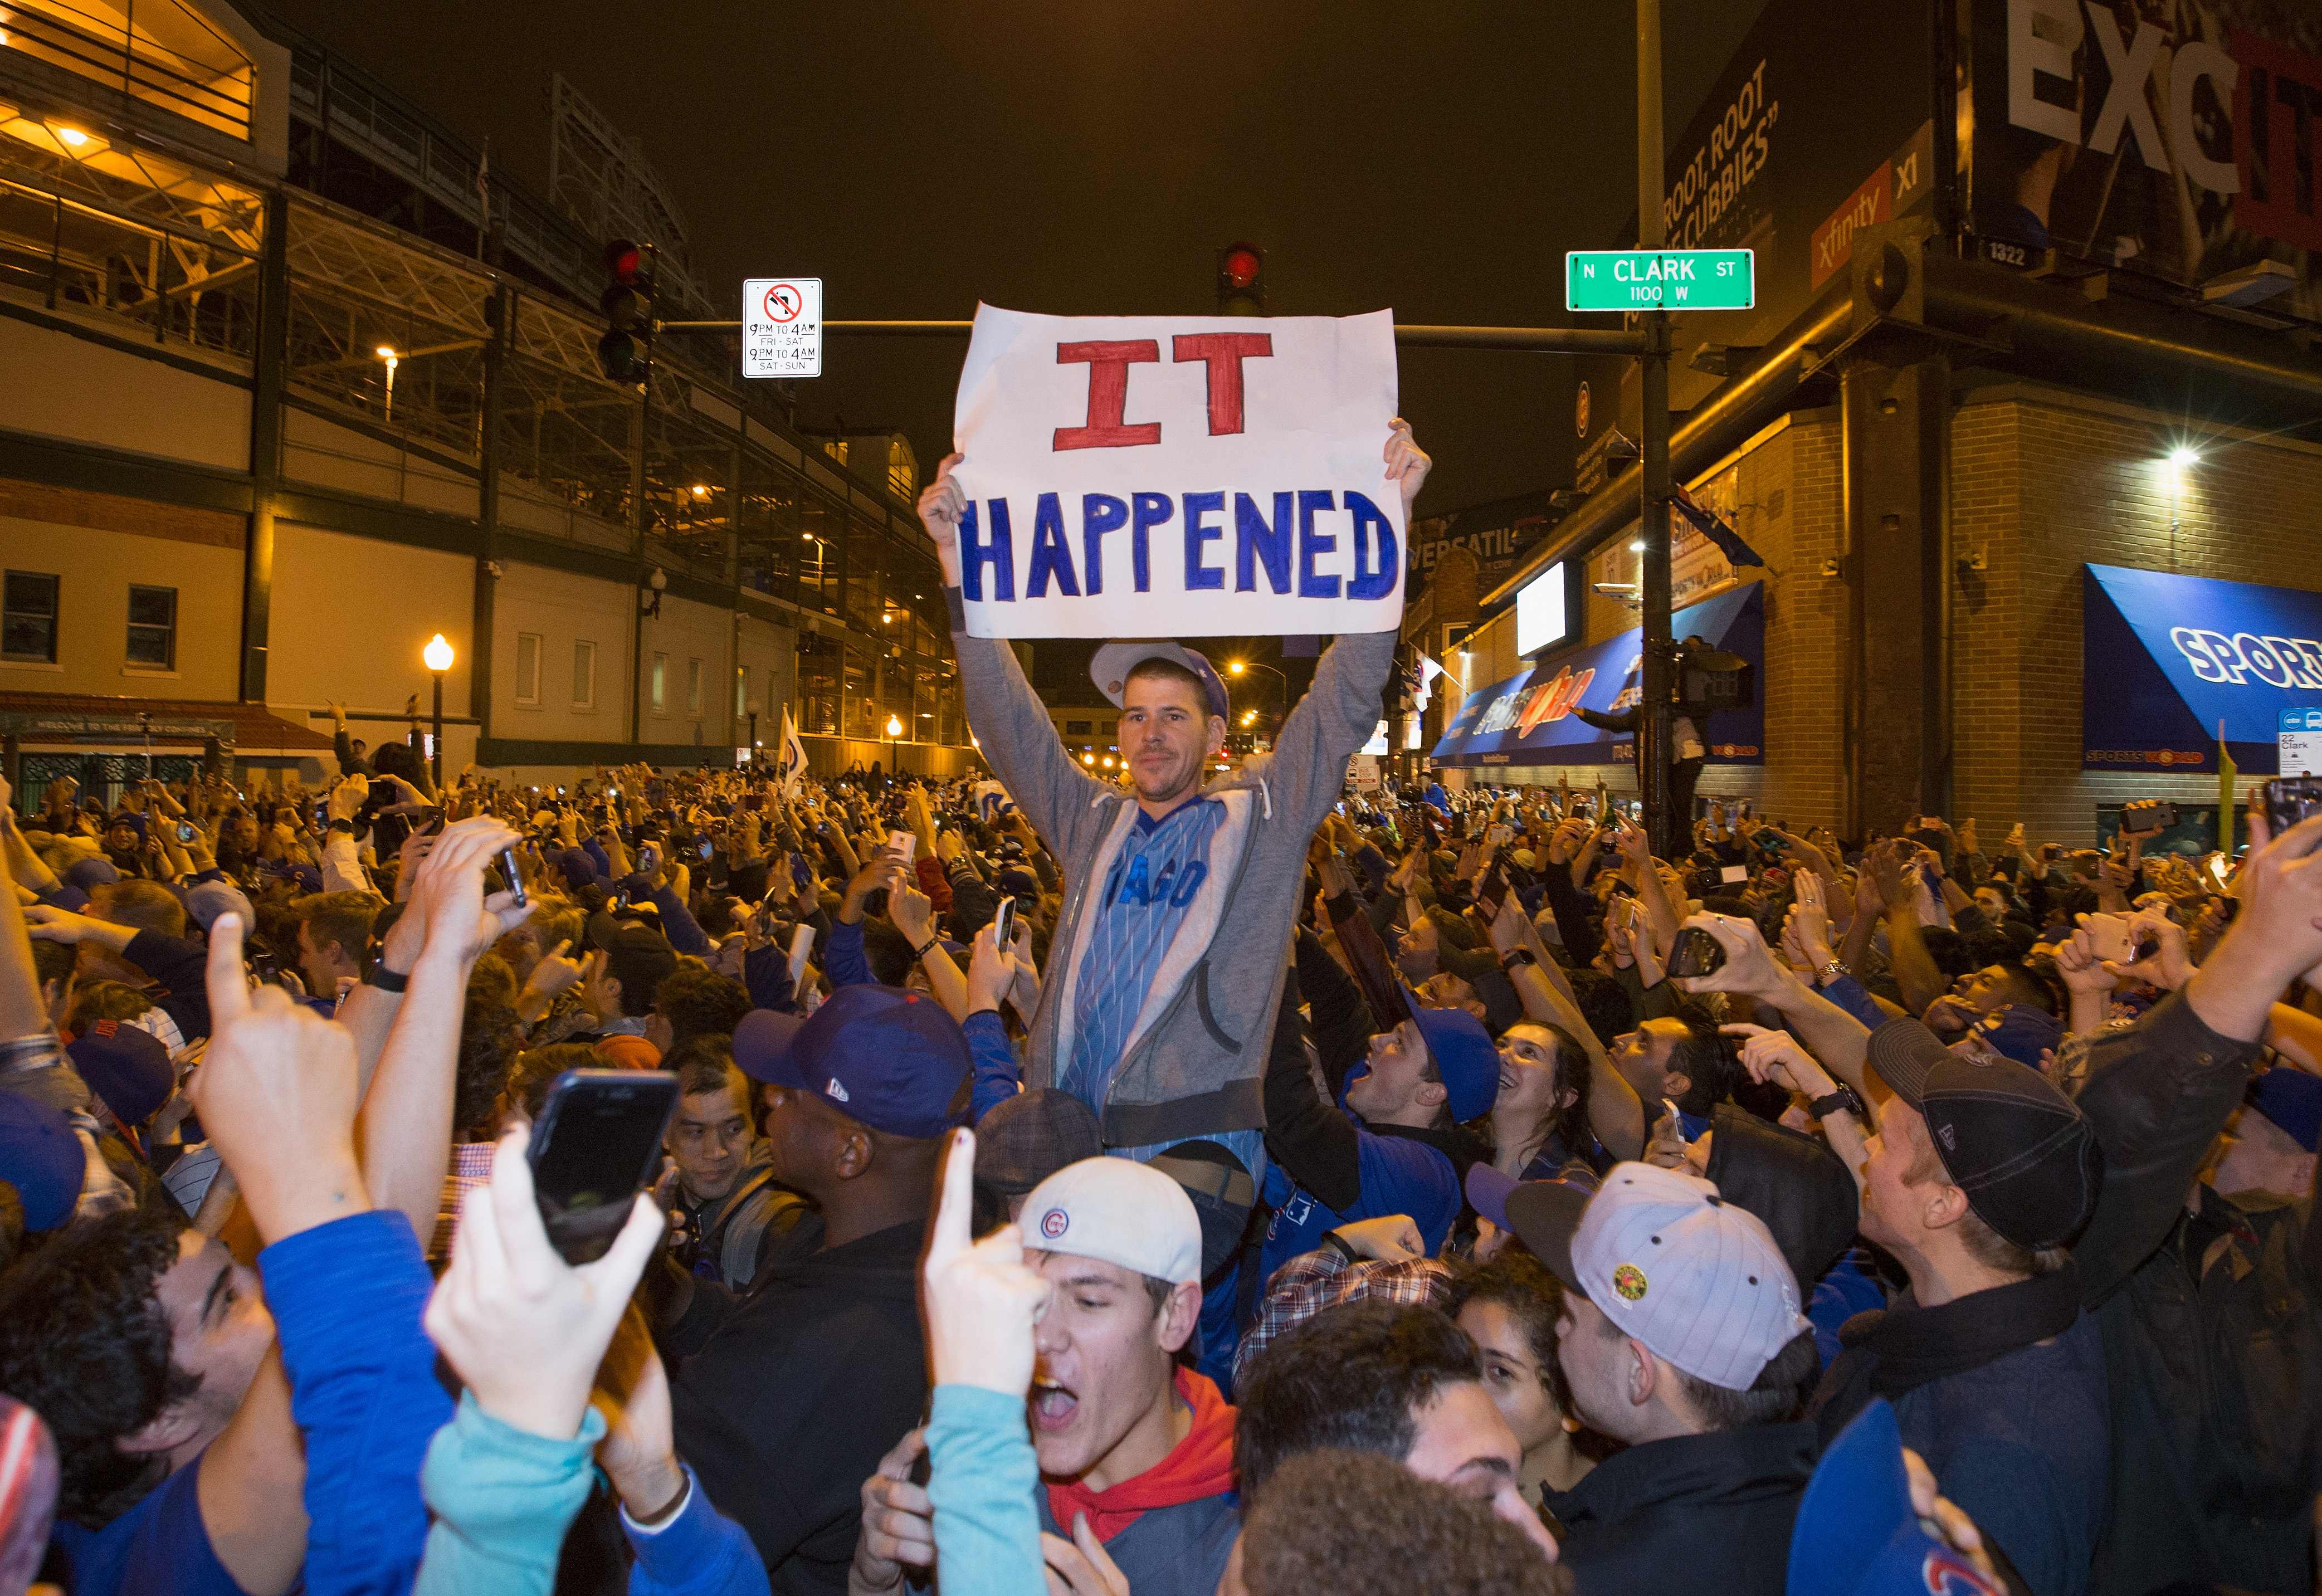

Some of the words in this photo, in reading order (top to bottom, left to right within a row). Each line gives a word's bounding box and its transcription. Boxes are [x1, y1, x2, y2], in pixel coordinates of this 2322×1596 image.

[1711, 58, 1766, 170] ROOT
[1819, 187, 1880, 267] xfinity
[1989, 242, 2025, 266] 1322
[1584, 264, 1595, 279] N
[1614, 259, 1695, 281] CLARK
[1716, 262, 1735, 276] ST
[1631, 286, 1662, 301] 1100
[1675, 286, 1689, 300] W
[777, 325, 788, 334] TO
[777, 349, 788, 359] TO
[1052, 333, 1274, 452] IT
[958, 490, 1399, 602] HAPPENED
